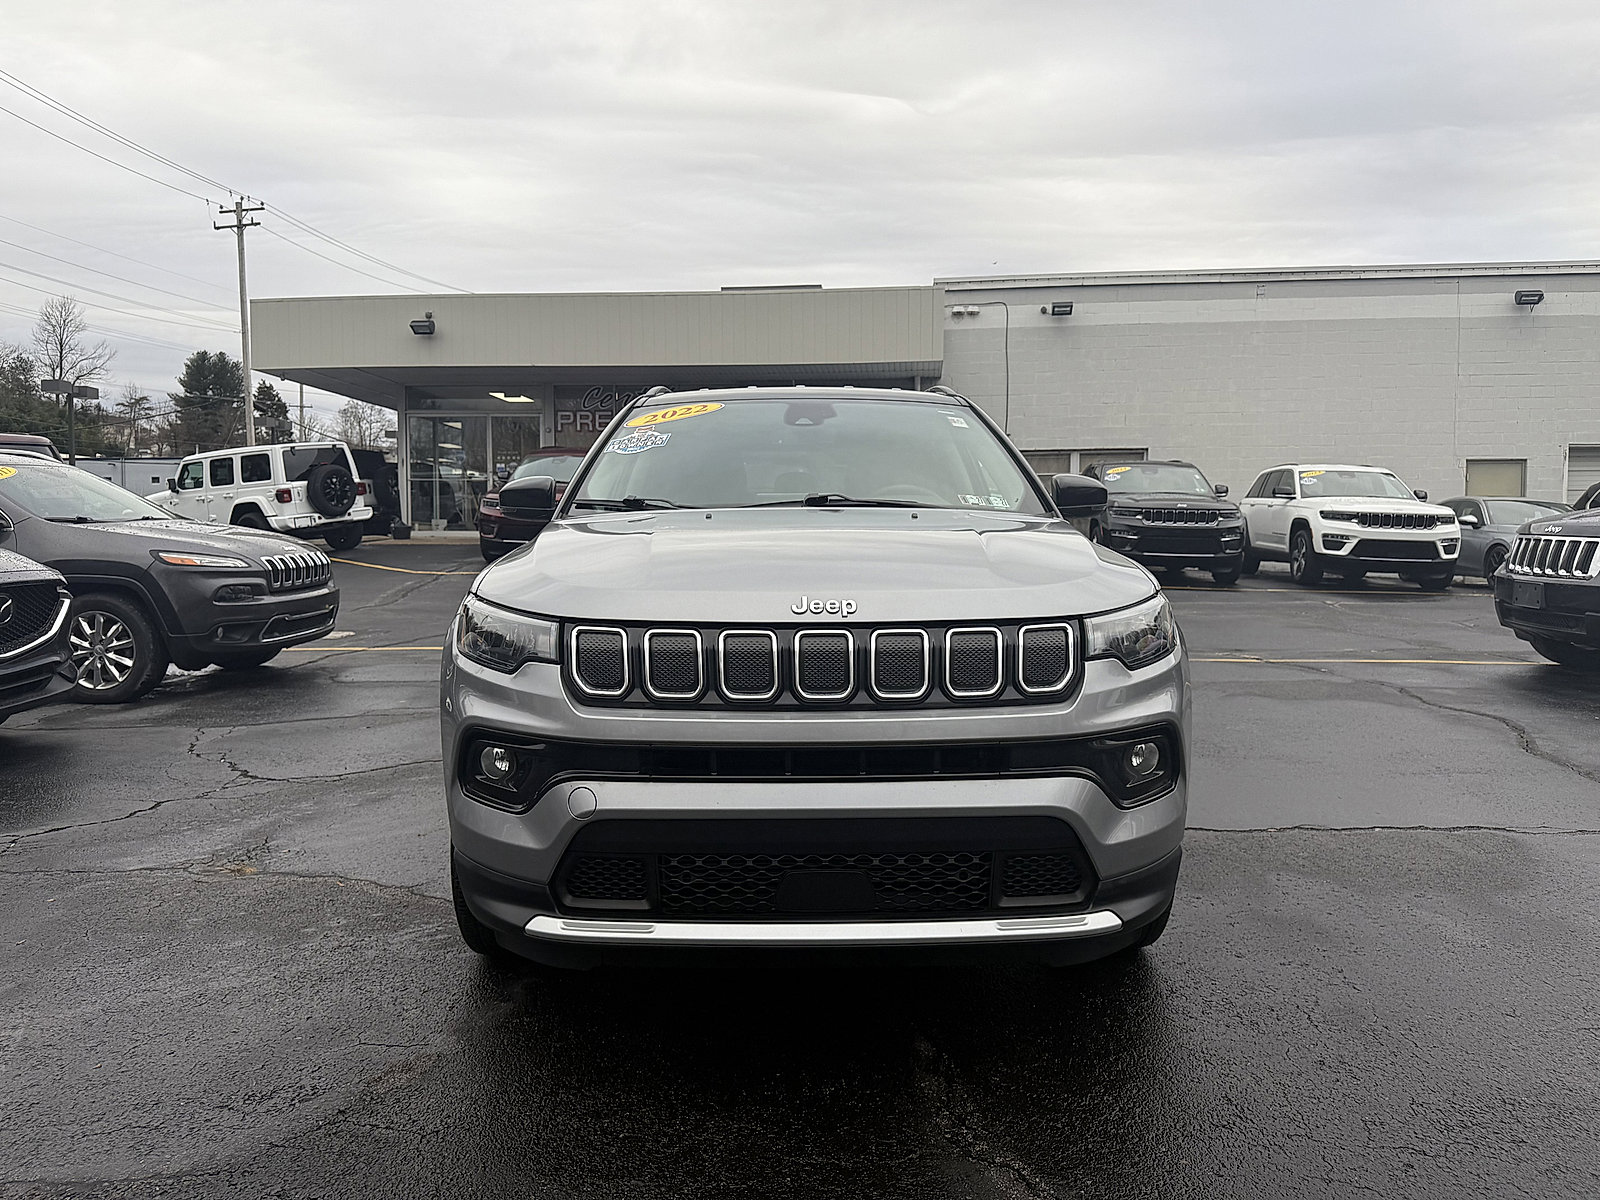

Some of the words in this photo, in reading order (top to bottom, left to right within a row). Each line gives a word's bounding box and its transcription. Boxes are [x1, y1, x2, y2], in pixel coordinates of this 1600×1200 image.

[582, 386, 648, 409] Cen
[644, 404, 708, 424] 2022
[791, 595, 858, 618] Jeep
